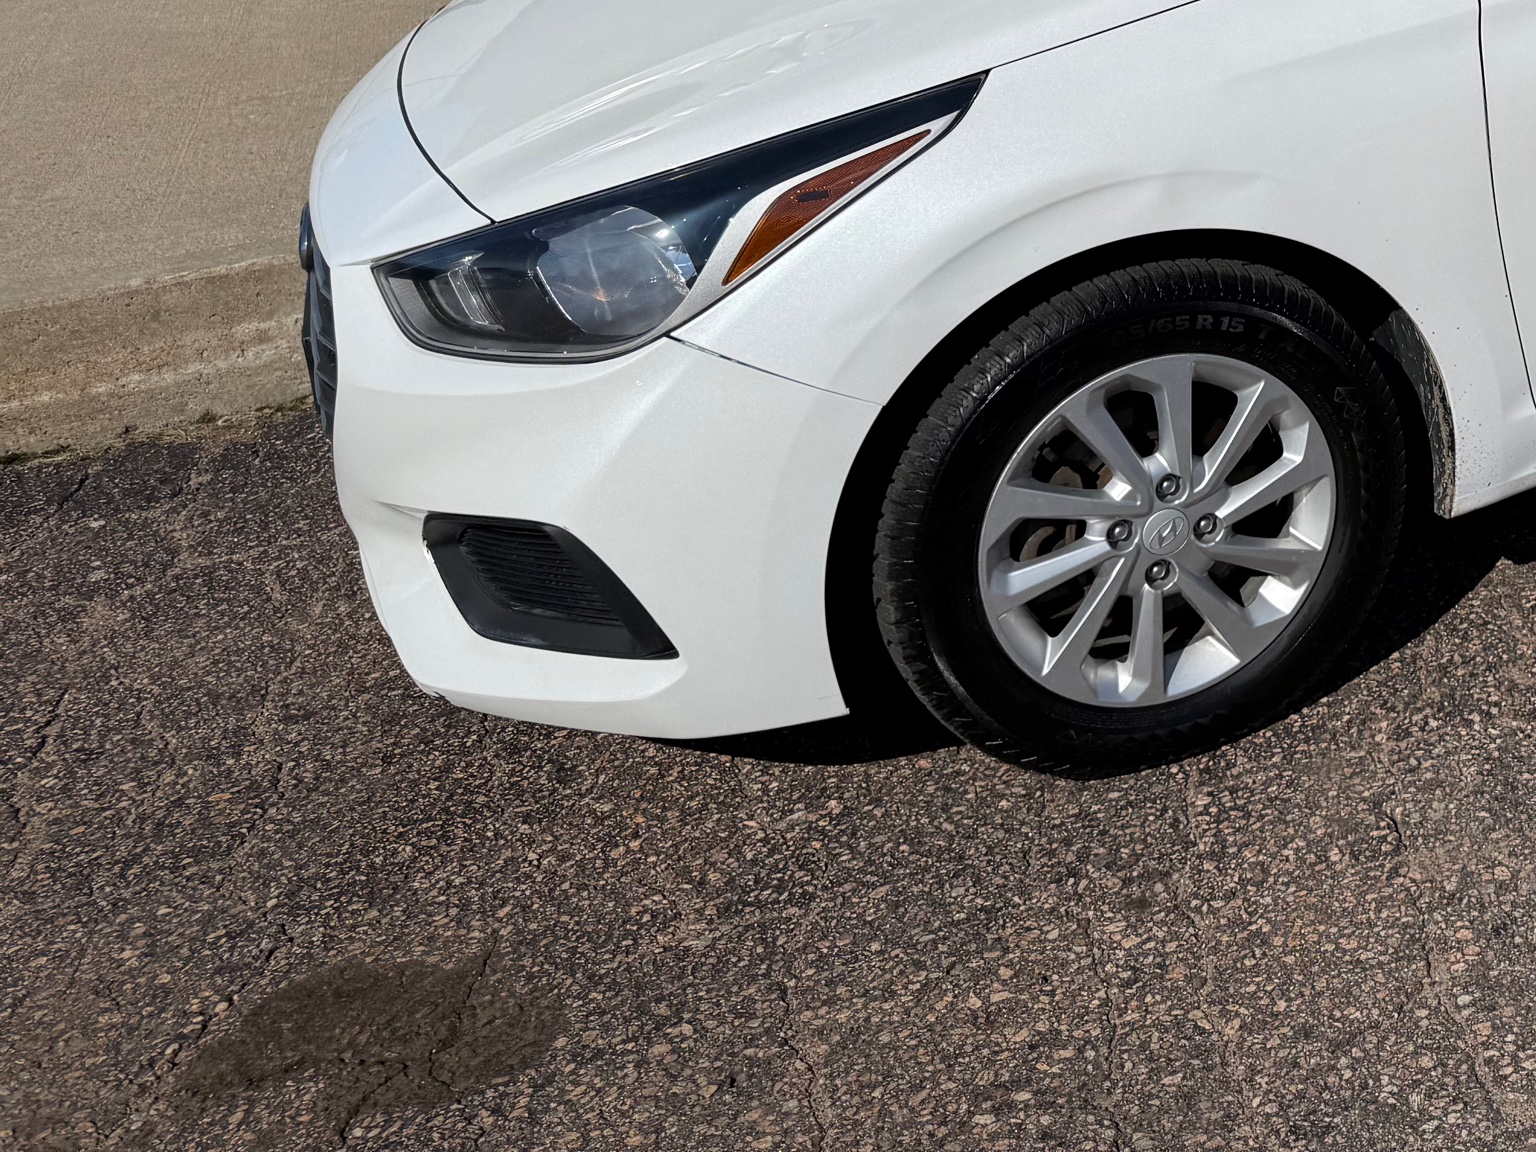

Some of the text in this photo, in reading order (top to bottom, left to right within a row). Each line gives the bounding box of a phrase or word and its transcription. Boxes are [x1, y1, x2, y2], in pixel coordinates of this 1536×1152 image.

[1107, 314, 1191, 347] 5/65
[1195, 314, 1214, 330] R
[1219, 315, 1247, 333] 15
